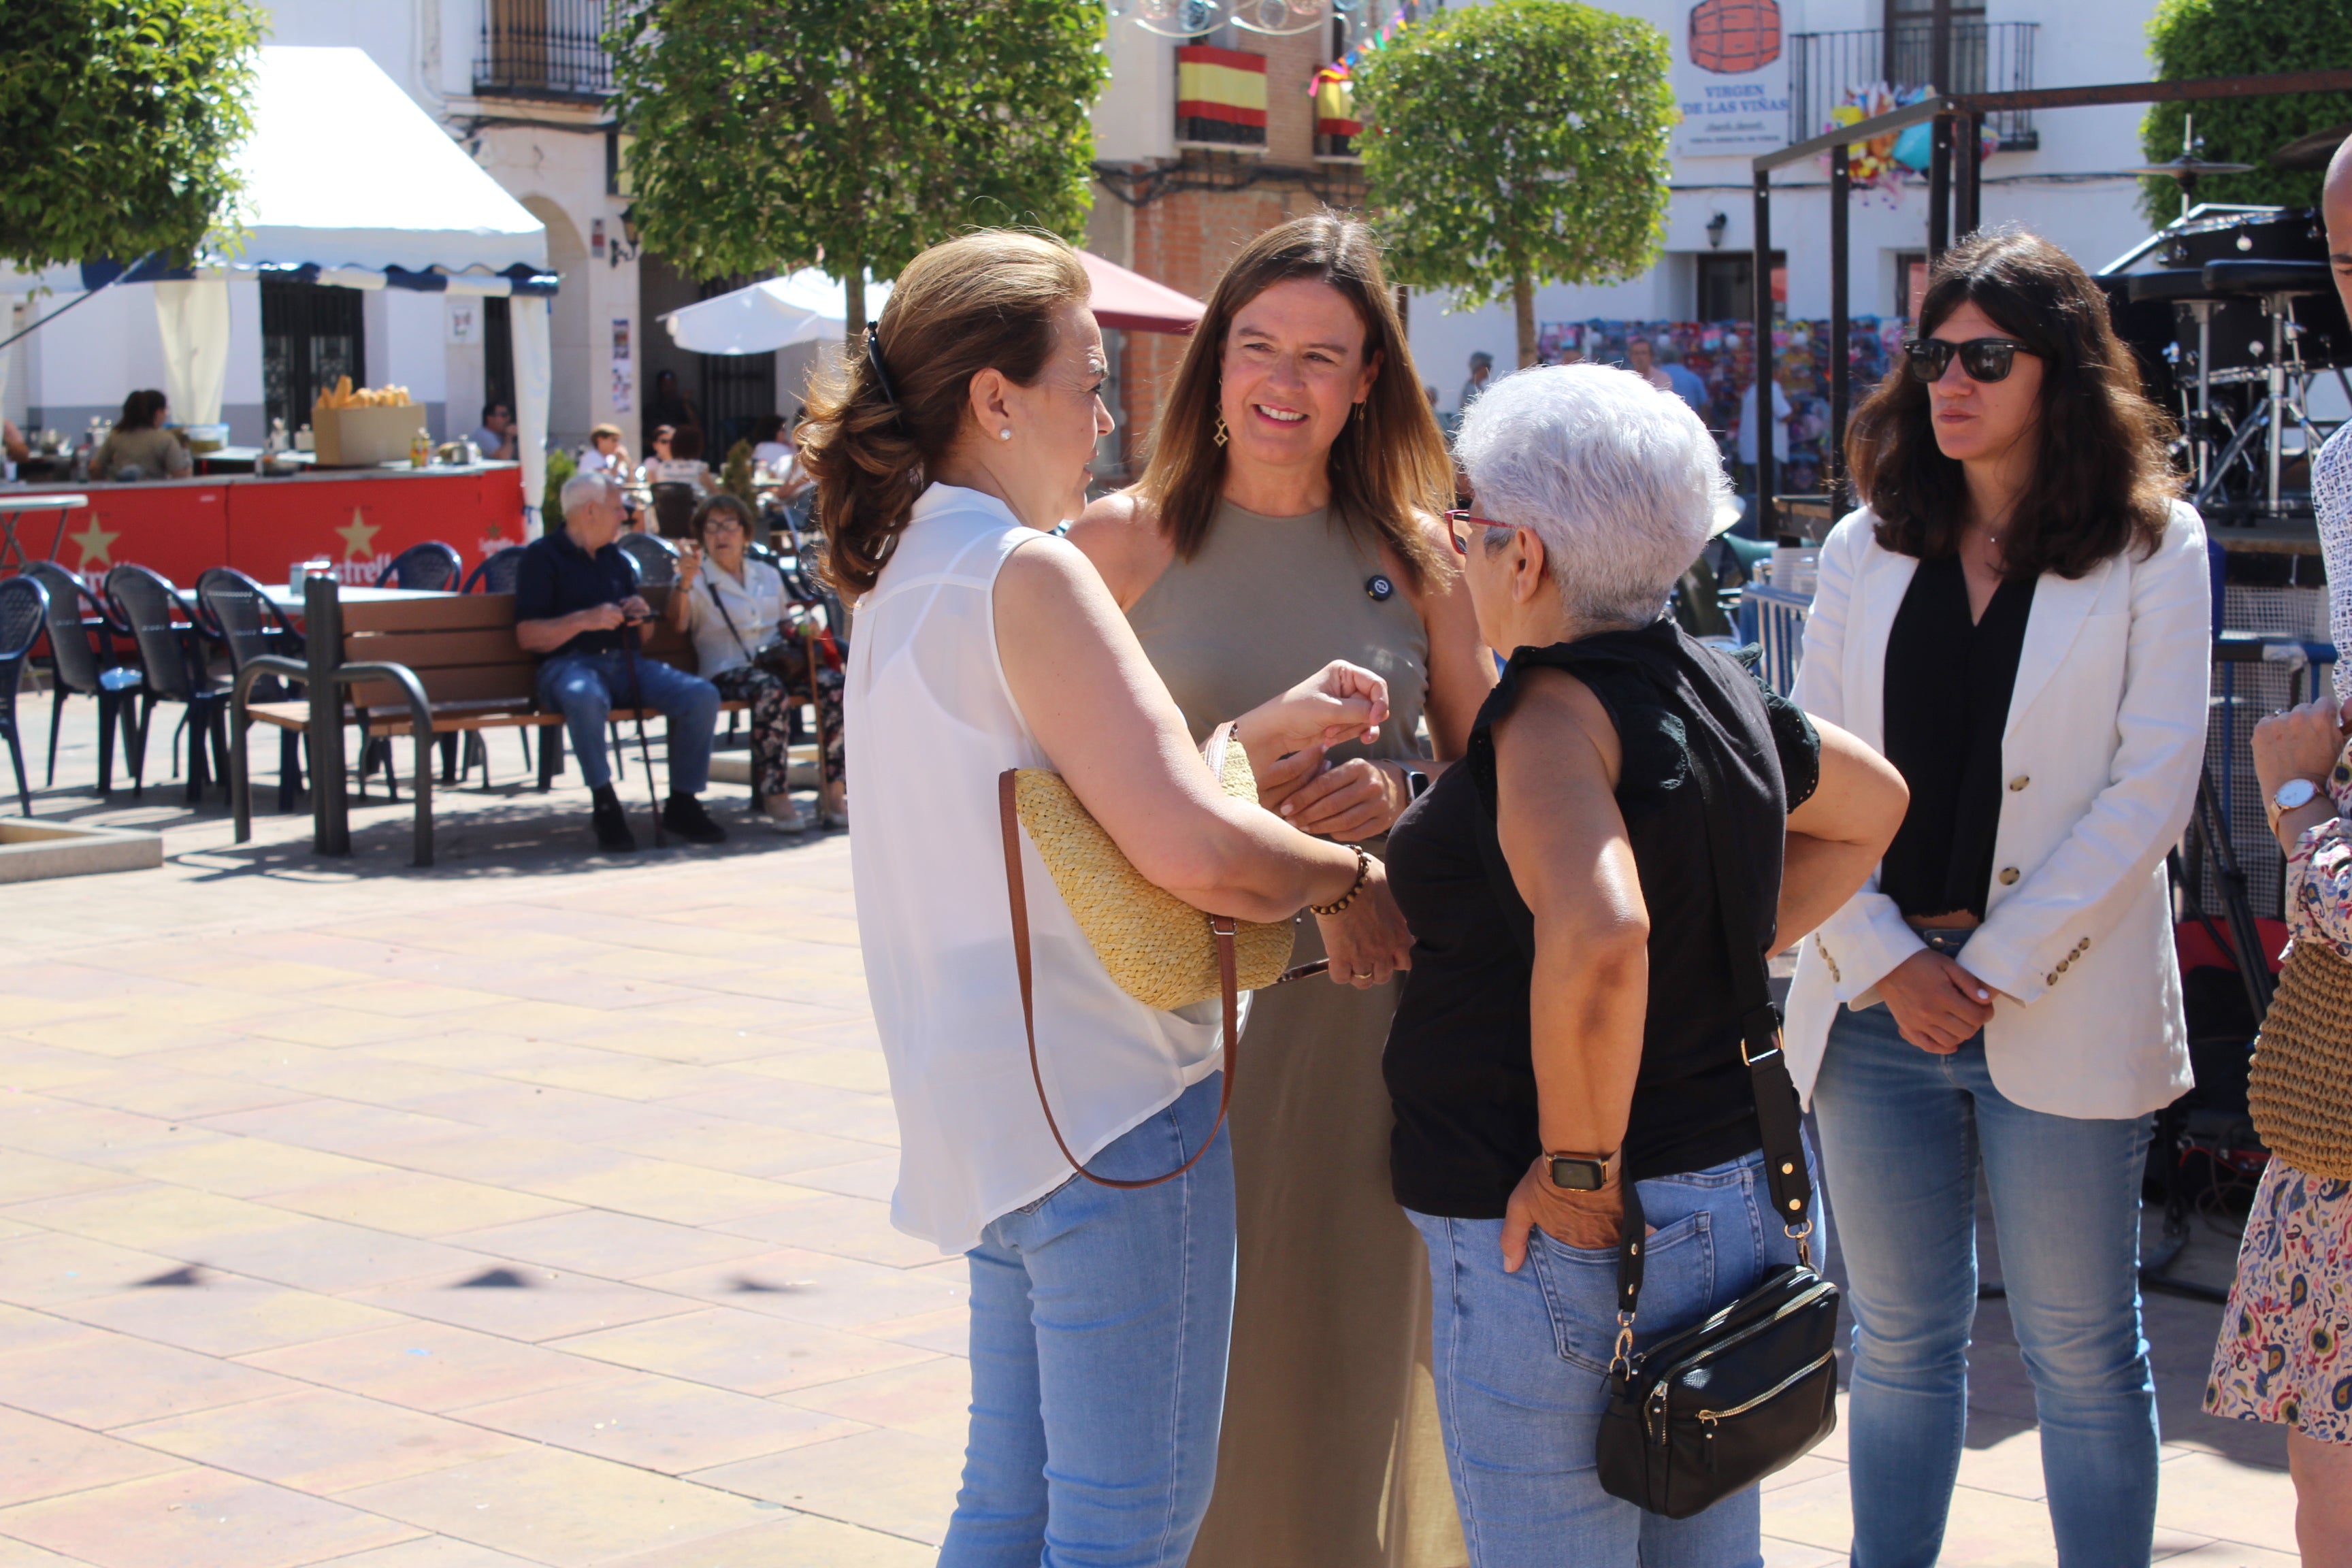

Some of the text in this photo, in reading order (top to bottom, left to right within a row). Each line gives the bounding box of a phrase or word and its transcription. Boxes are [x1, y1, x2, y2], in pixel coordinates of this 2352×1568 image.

[1705, 84, 1764, 98] VIRGEN
[1682, 102, 1703, 115] DE
[1707, 101, 1737, 114] LAS
[308, 553, 399, 584] strell
